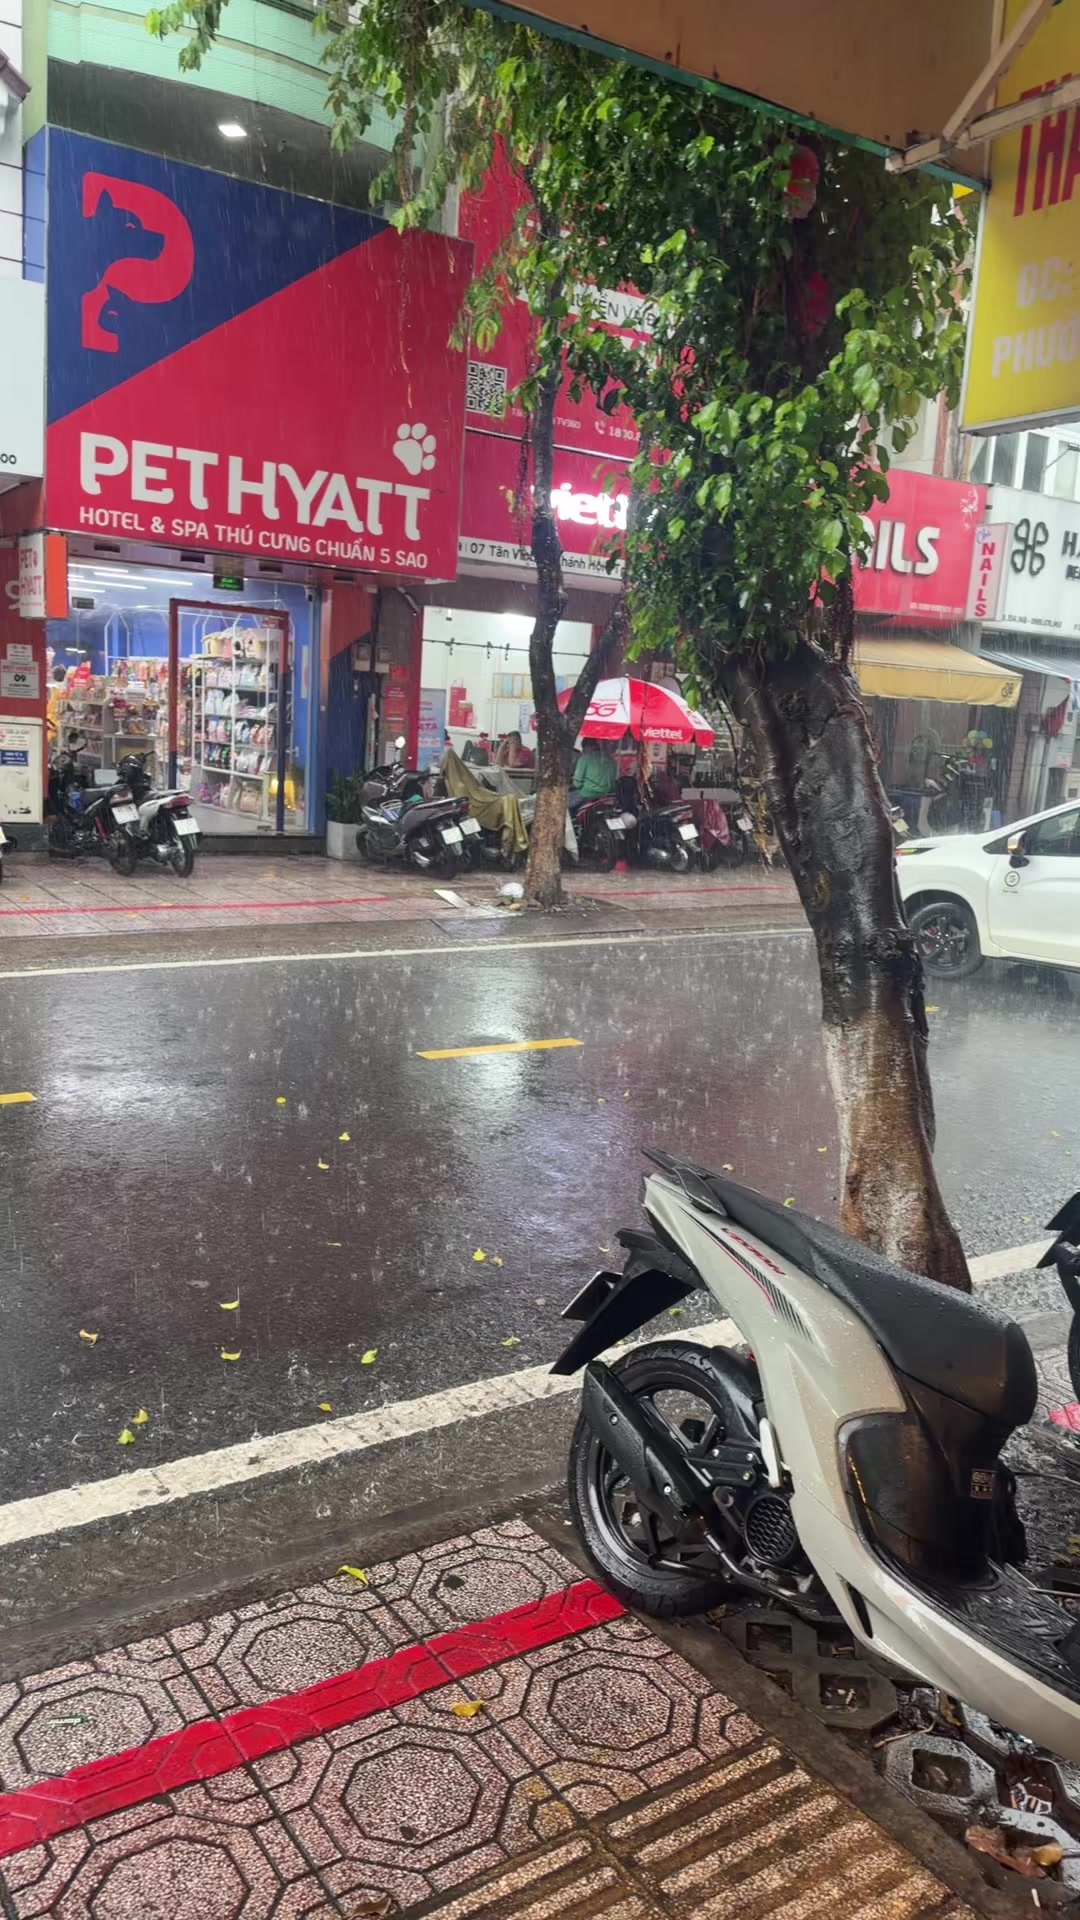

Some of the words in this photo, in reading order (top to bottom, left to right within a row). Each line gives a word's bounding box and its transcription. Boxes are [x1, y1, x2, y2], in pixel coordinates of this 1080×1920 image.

[79, 506, 145, 531] HOTEL
[150, 516, 165, 534] &
[171, 519, 209, 539] SPA
[214, 524, 253, 546] THÚ
[258, 531, 311, 553] CƯNG
[315, 538, 375, 562] CHUẨN
[380, 548, 391, 564] 5
[395, 550, 428, 569] SAO
[470, 543, 485, 556] 07
[489, 544, 510, 558] Tân
[1062, 530, 1080, 557] H
[974, 542, 996, 617] NAILS
[641, 727, 683, 740] viettel
